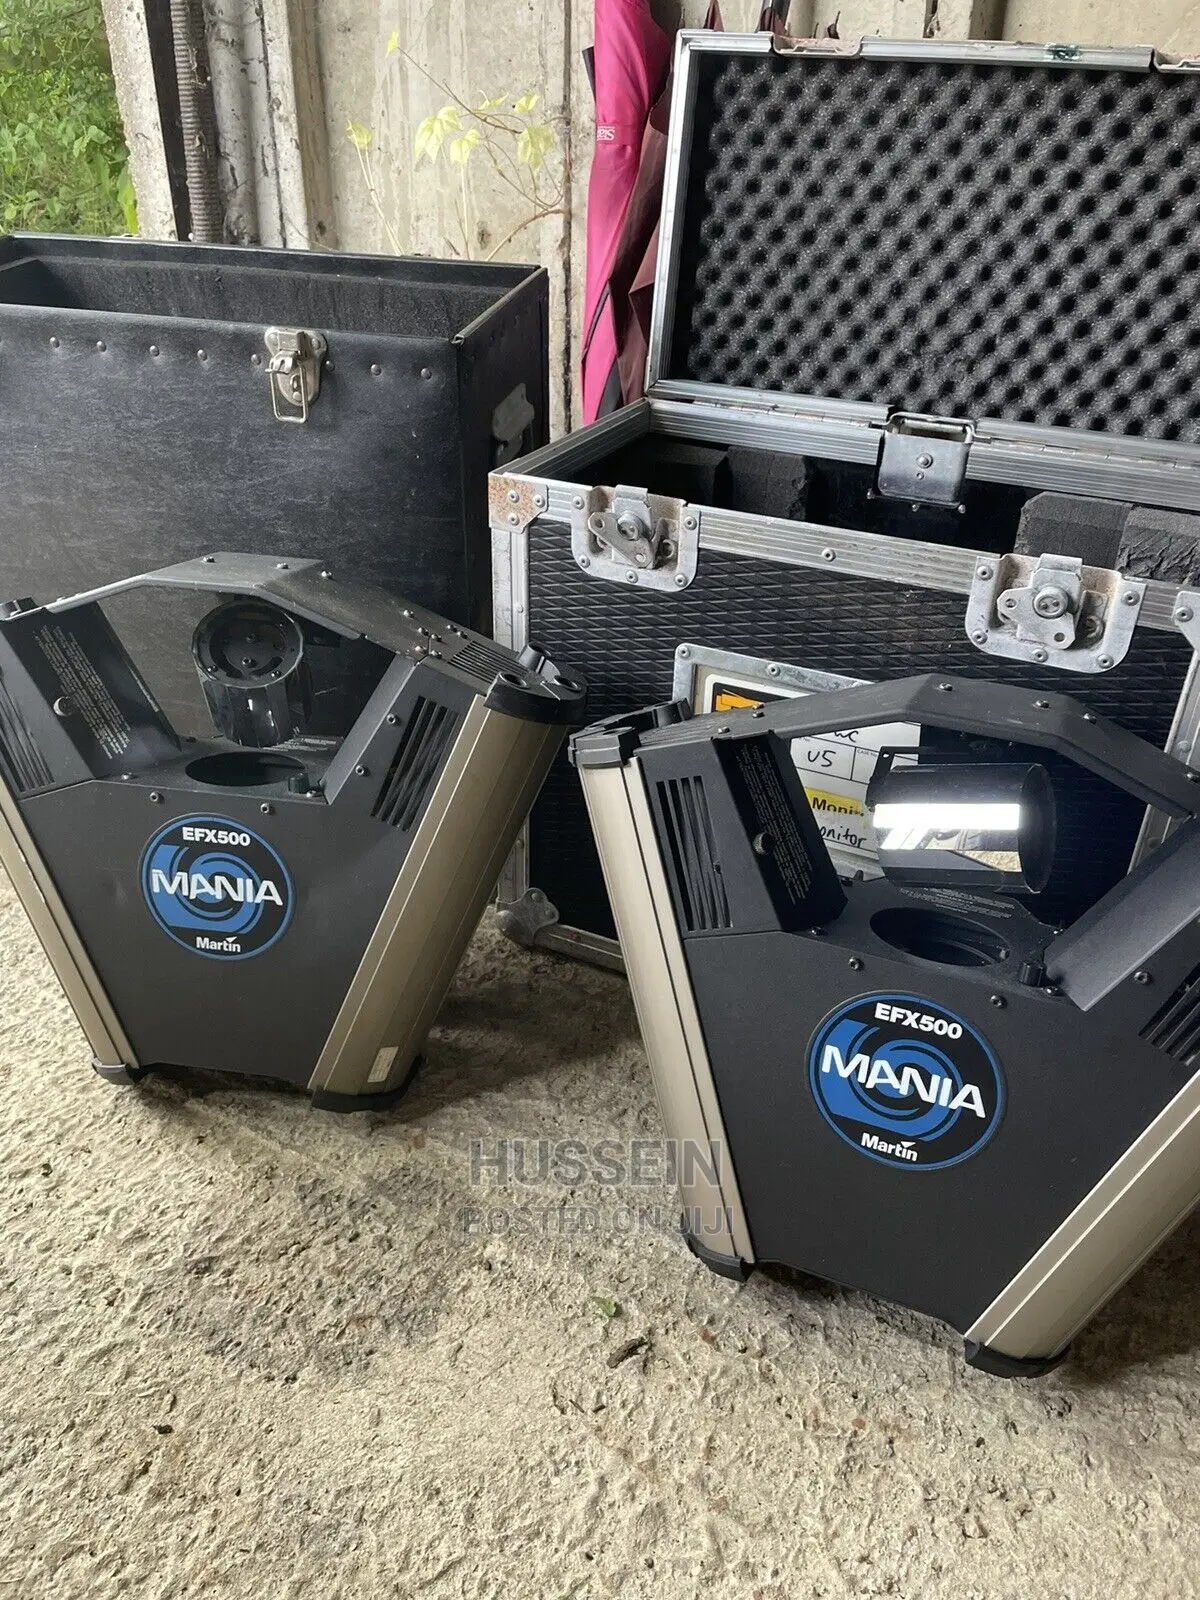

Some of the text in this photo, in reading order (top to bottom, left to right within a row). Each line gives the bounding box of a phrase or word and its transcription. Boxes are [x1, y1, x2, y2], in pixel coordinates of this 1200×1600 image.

[182, 826, 251, 847] EFX500
[820, 826, 867, 849] onitor
[151, 869, 283, 906] MANIA
[196, 936, 241, 953] Martin
[874, 1002, 963, 1040] EFX500
[821, 1044, 986, 1119] MANIA
[861, 1132, 918, 1162] Martin
